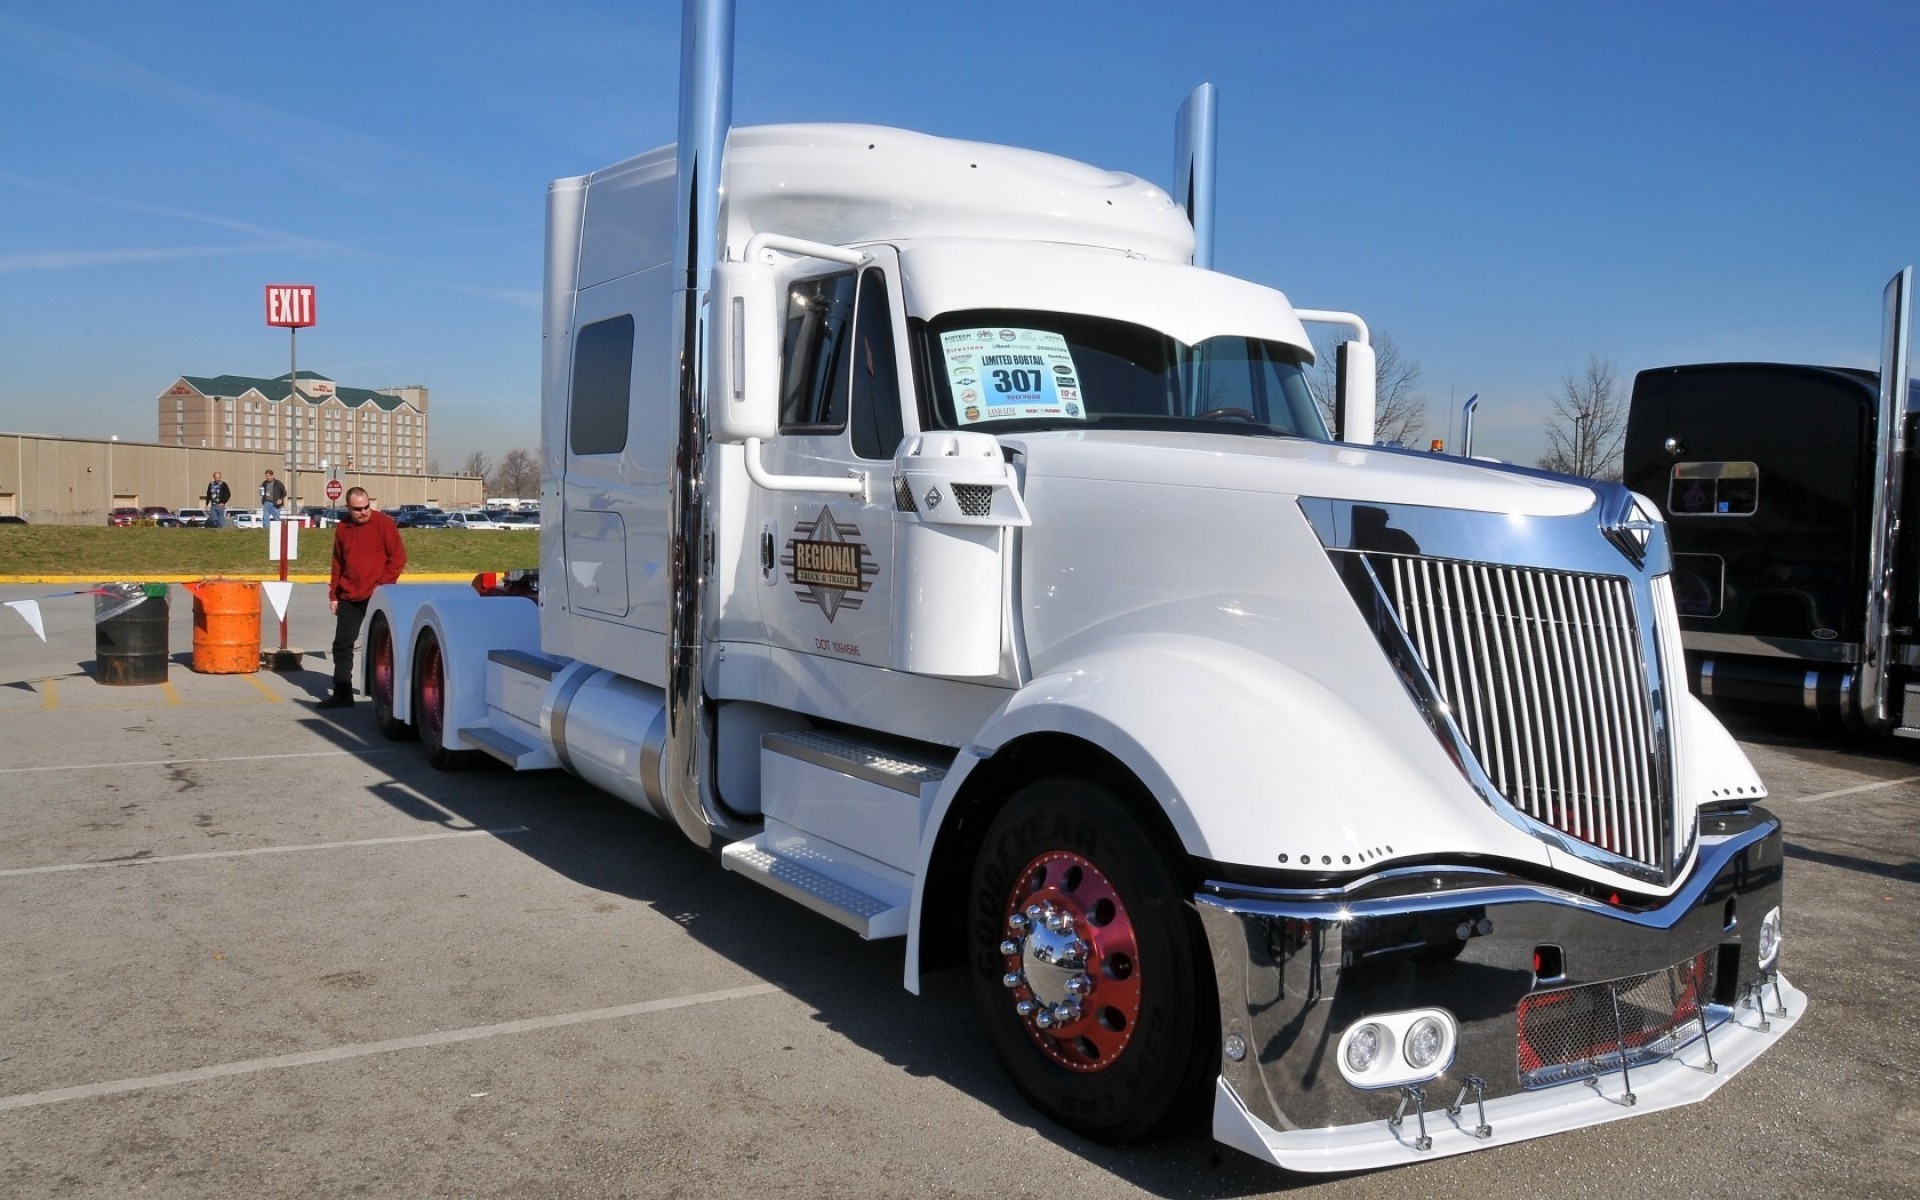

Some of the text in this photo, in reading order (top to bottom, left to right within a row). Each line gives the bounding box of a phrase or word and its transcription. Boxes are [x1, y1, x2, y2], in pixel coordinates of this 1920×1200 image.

[270, 289, 311, 322] EXIT
[981, 355, 1012, 366] LIMITED
[1013, 354, 1045, 366] BOBTAIL
[992, 369, 1042, 393] 307
[796, 543, 858, 574] REGIONAL
[799, 571, 820, 581] TRUCK
[828, 574, 856, 585] TRAILER
[815, 638, 830, 650] DOT
[975, 809, 1098, 980] GOODYEAR
